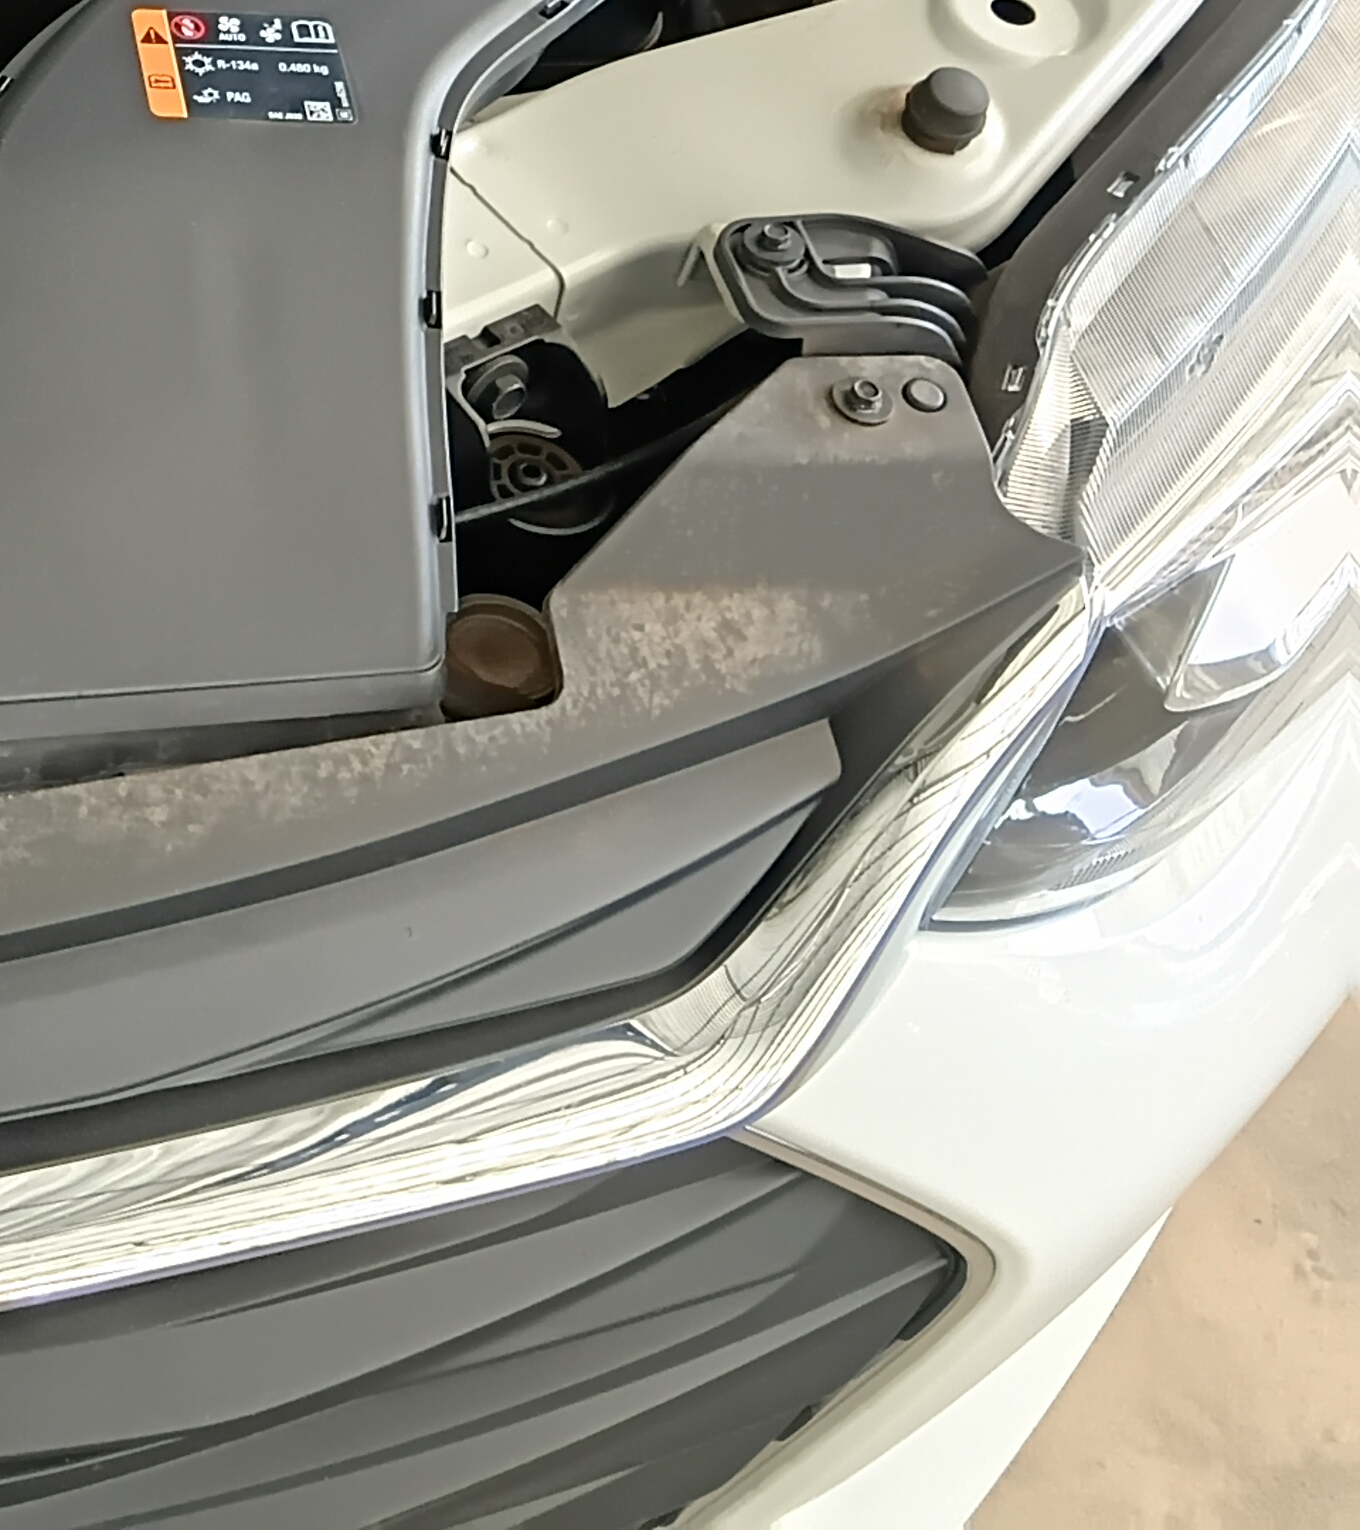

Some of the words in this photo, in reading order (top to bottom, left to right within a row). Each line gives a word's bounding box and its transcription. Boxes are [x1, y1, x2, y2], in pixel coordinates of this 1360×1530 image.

[219, 33, 246, 42] AUTO
[217, 59, 259, 71] R-134a
[226, 92, 252, 103] PAG
